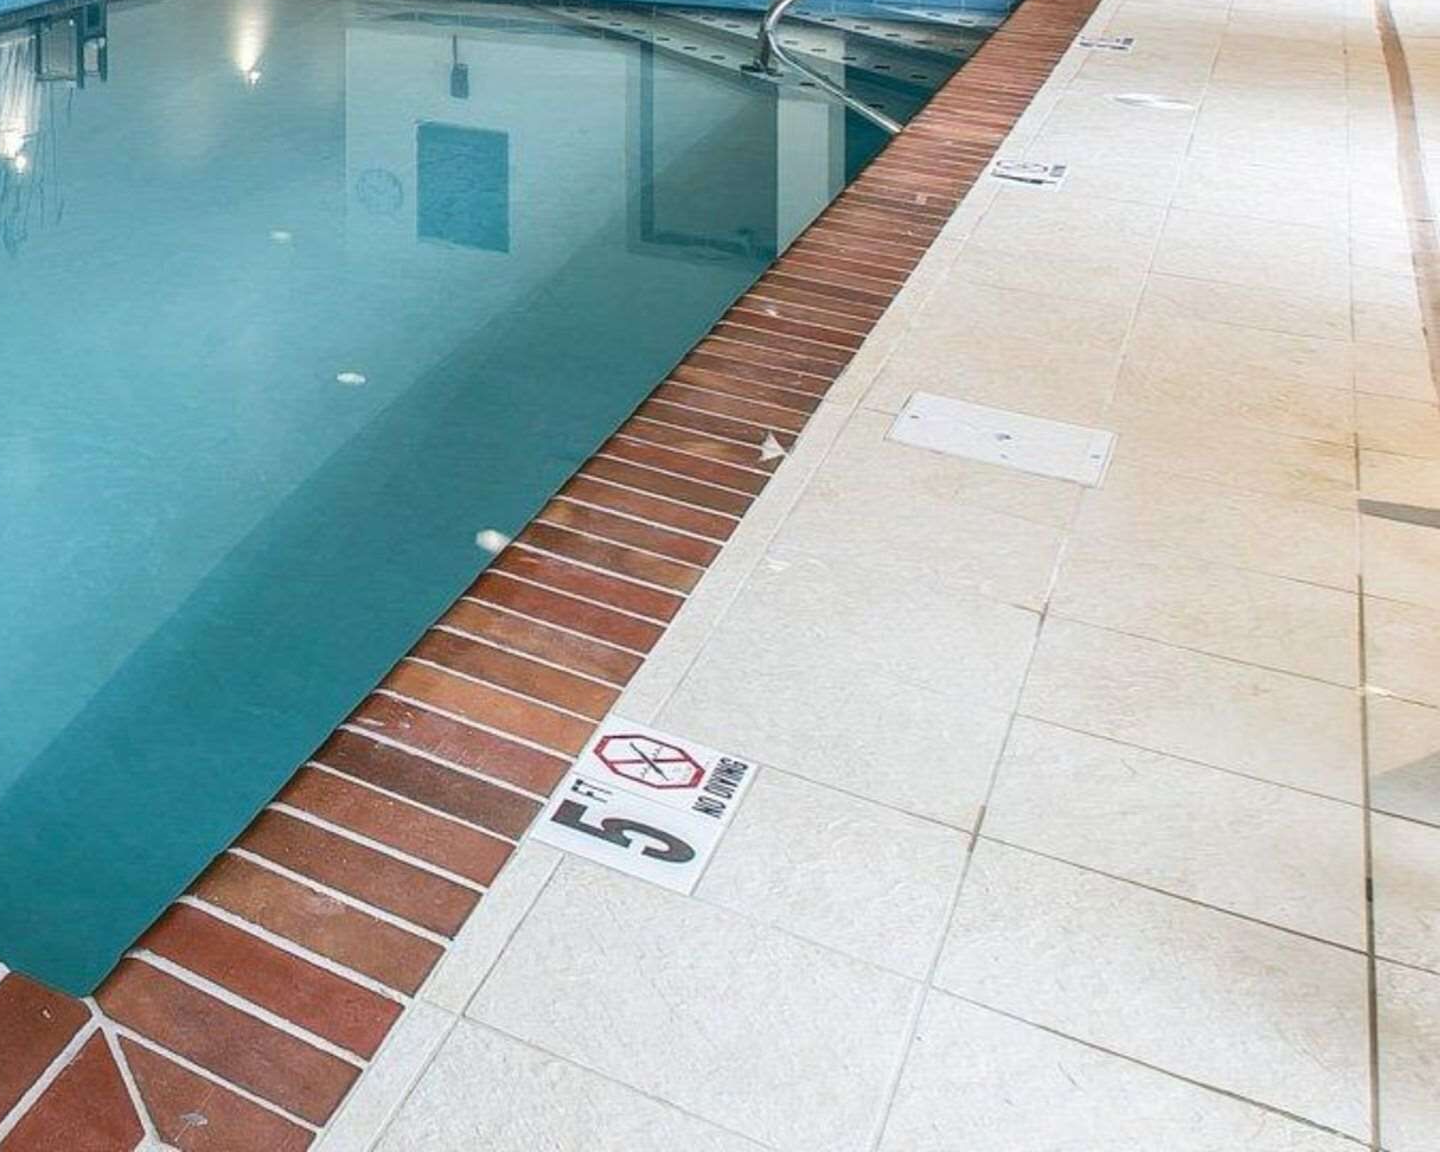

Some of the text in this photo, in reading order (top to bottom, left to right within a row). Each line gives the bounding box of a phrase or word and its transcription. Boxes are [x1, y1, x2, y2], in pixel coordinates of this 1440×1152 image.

[550, 778, 696, 864] 5 FT
[691, 757, 749, 820] NO DIVING
